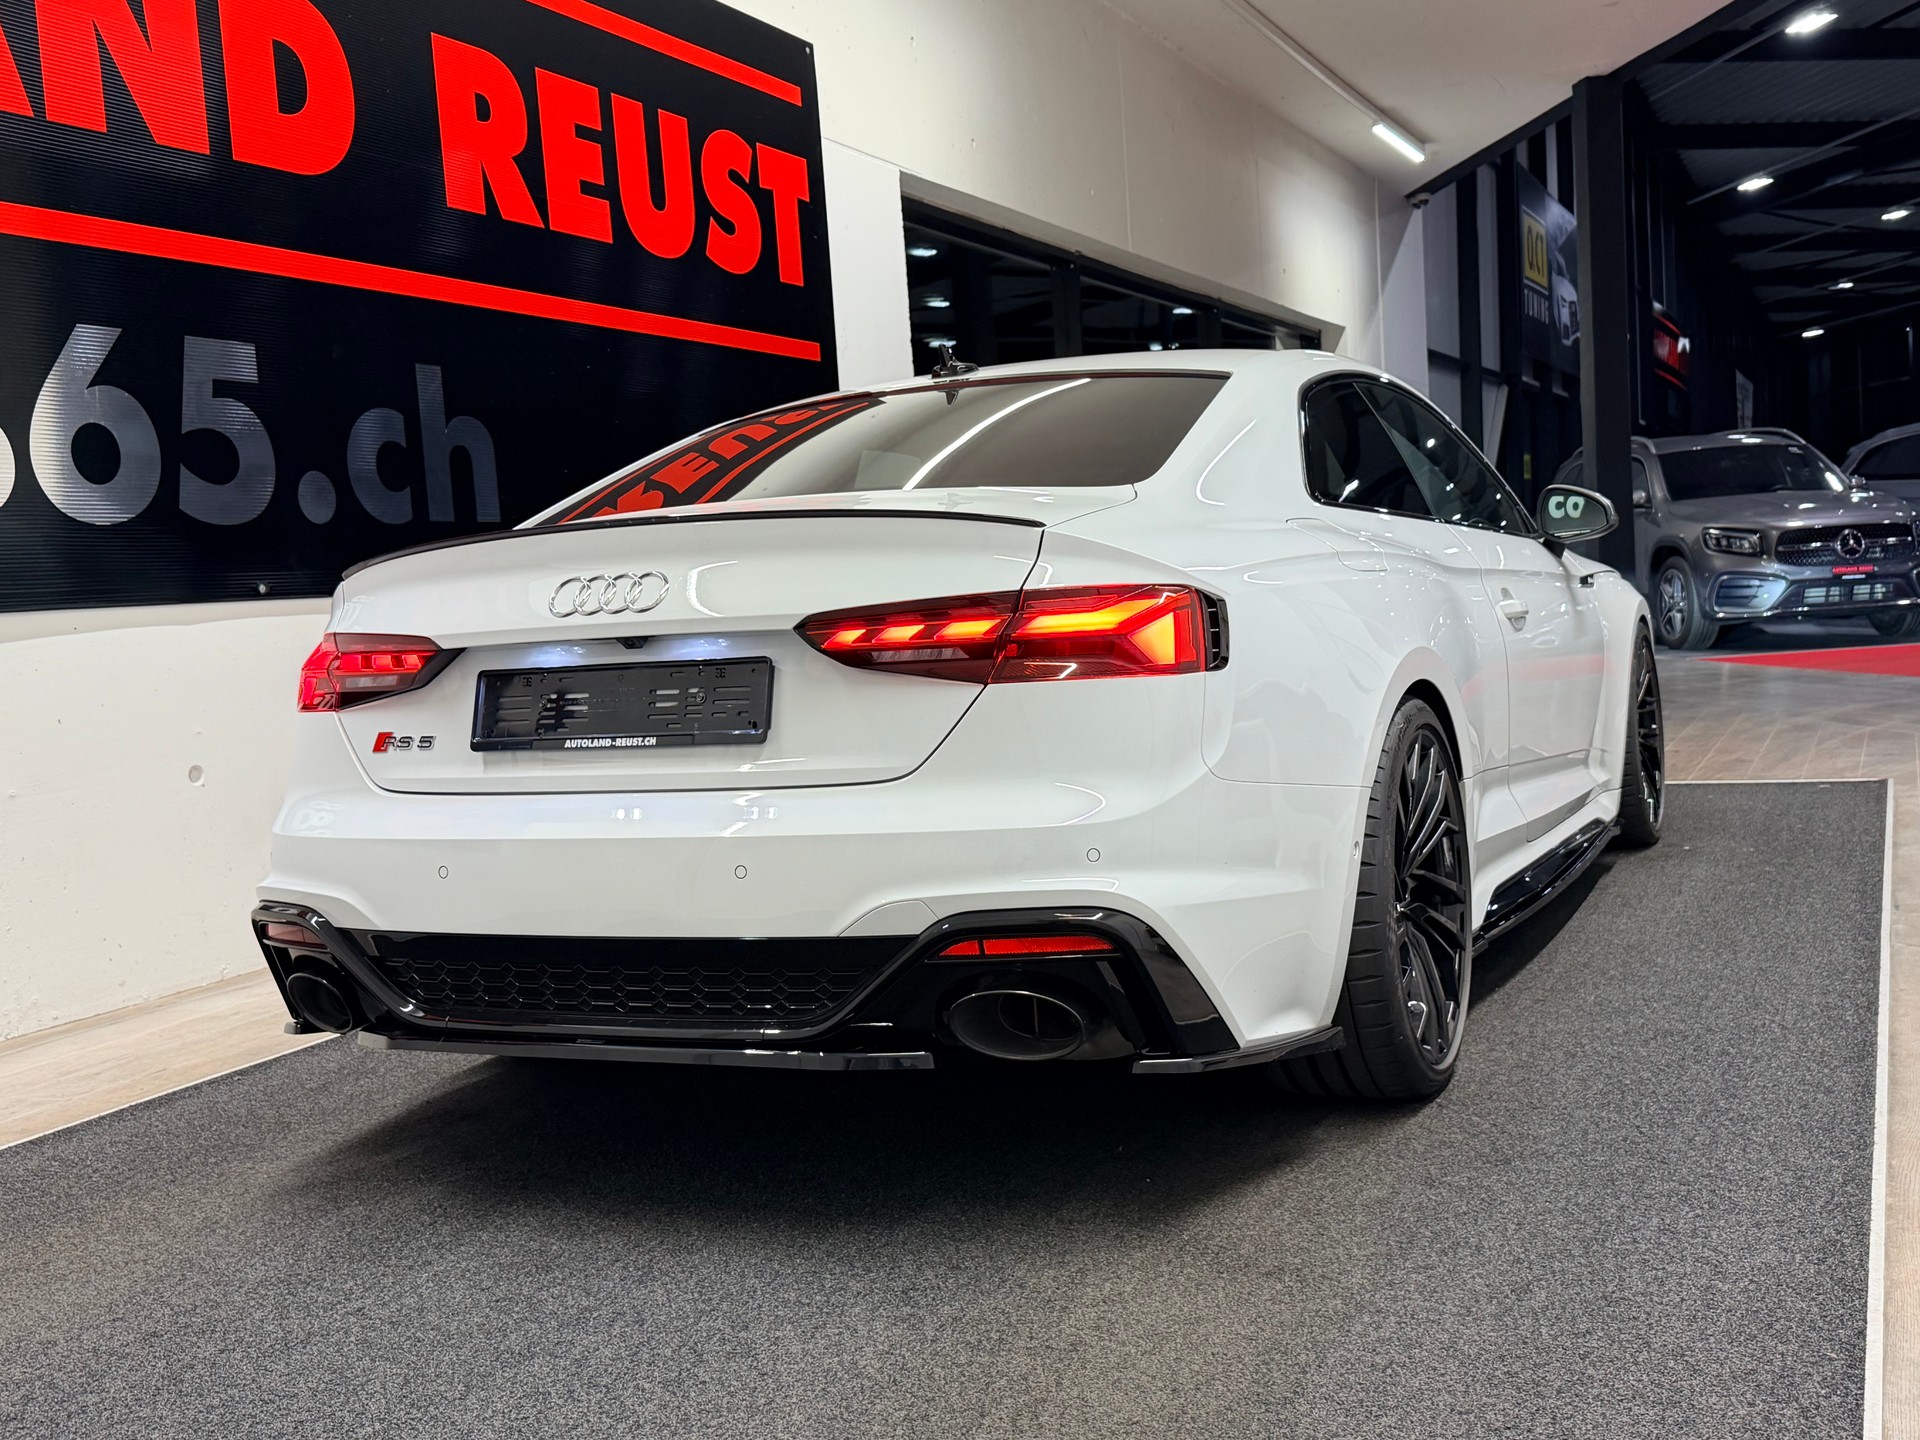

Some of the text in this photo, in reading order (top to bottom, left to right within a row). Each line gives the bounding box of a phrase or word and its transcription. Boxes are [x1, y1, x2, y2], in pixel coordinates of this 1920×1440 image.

[0, 0, 810, 287] ND REUST
[0, 324, 501, 526] 65.ch
[377, 734, 437, 751] RS 5
[564, 737, 657, 748] AUTOLAND-REUST.CH
